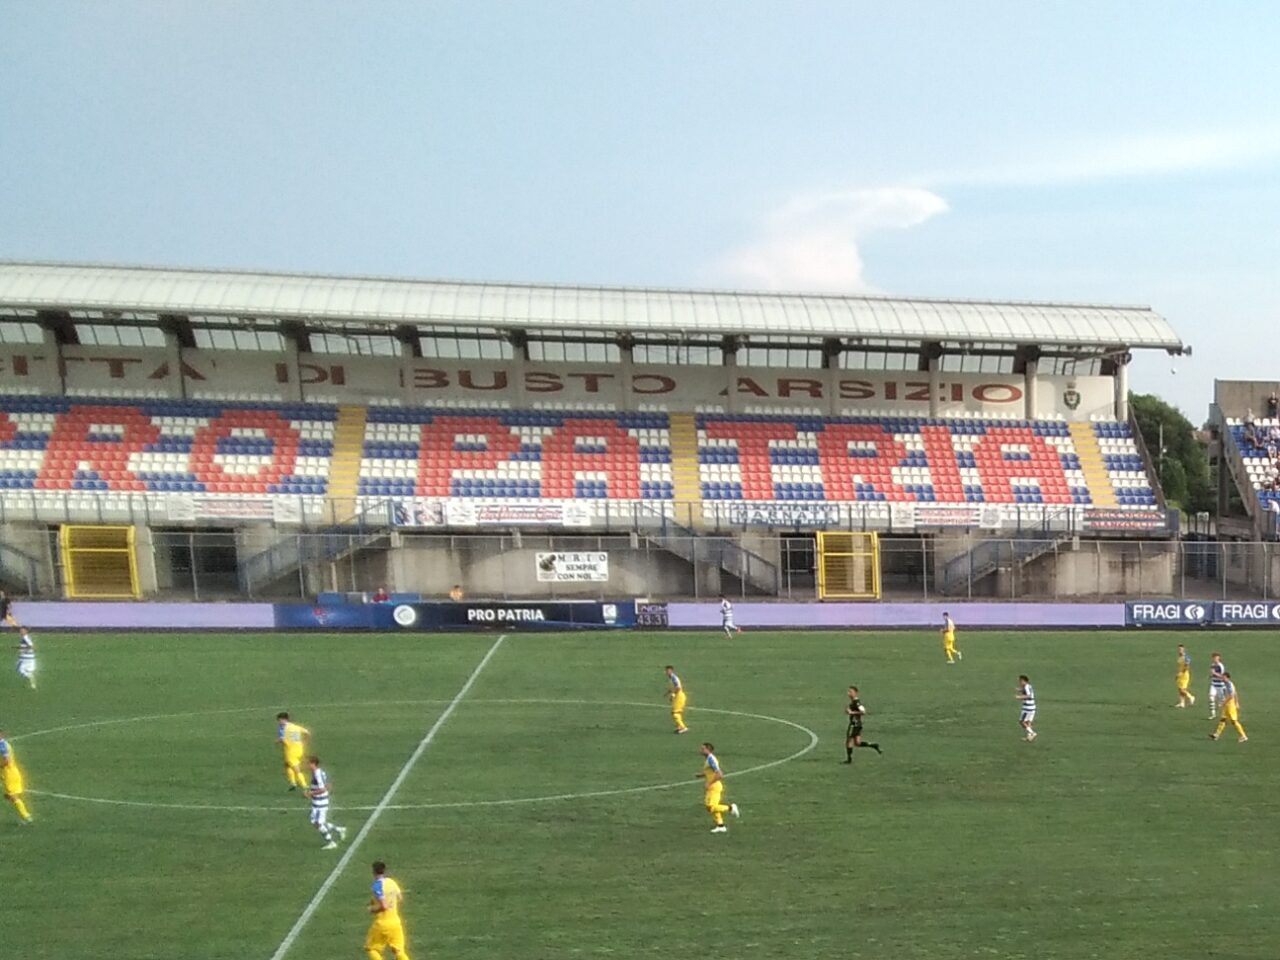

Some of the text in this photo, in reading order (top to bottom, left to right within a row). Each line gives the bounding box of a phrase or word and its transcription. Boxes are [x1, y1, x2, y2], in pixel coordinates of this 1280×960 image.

[275, 362, 345, 386] DI
[400, 367, 677, 394] BUSTO
[719, 376, 1023, 403] ARSIZIO
[0, 403, 1074, 504] RO PATRIA
[467, 609, 545, 621] PRO PATRIA
[1133, 604, 1181, 619] FRAGI
[1222, 604, 1268, 619] FRAGI
